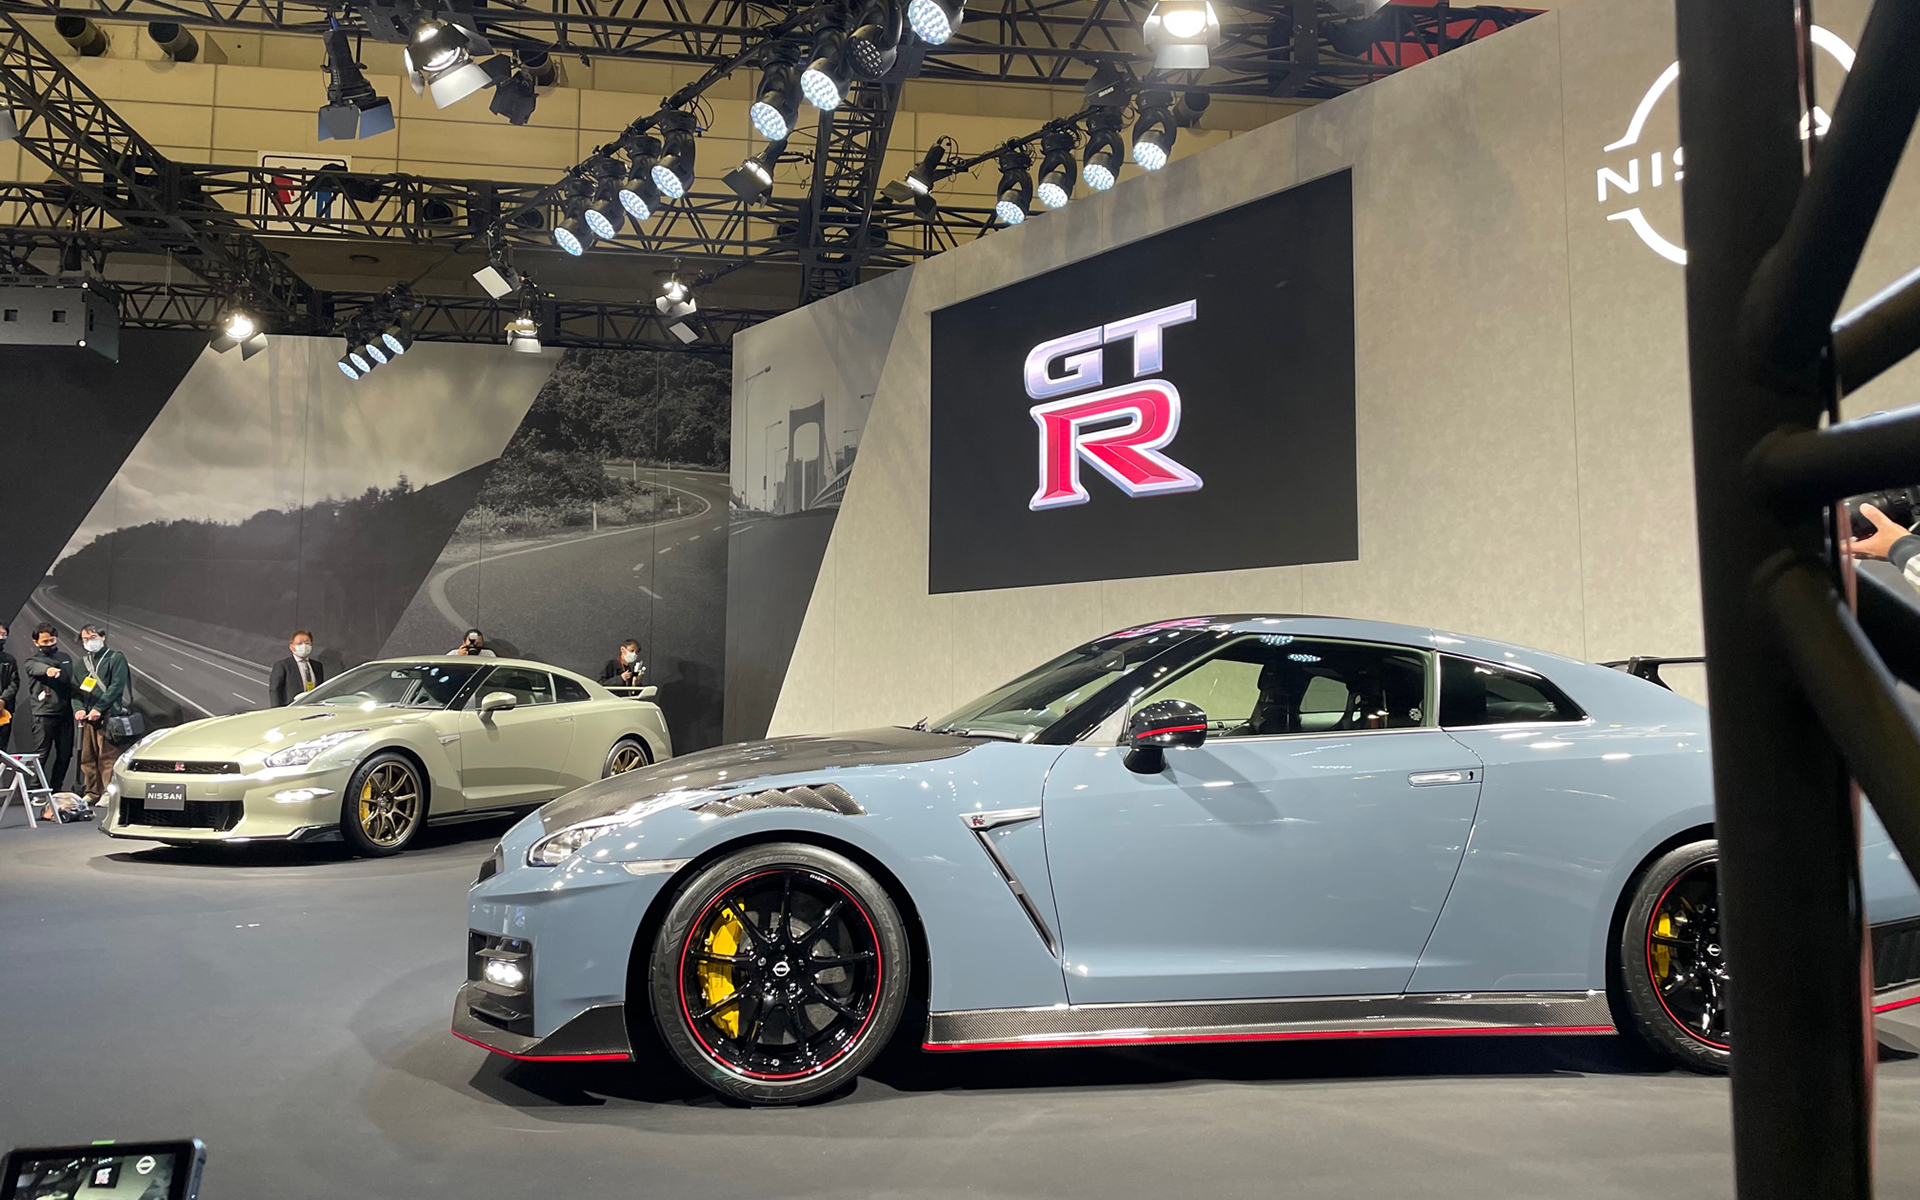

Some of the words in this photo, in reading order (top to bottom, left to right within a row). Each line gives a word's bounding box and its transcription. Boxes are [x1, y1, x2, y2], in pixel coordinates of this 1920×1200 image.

[1024, 299, 1197, 399] GT
[1029, 379, 1203, 511] R
[147, 792, 182, 800] NISSAN
